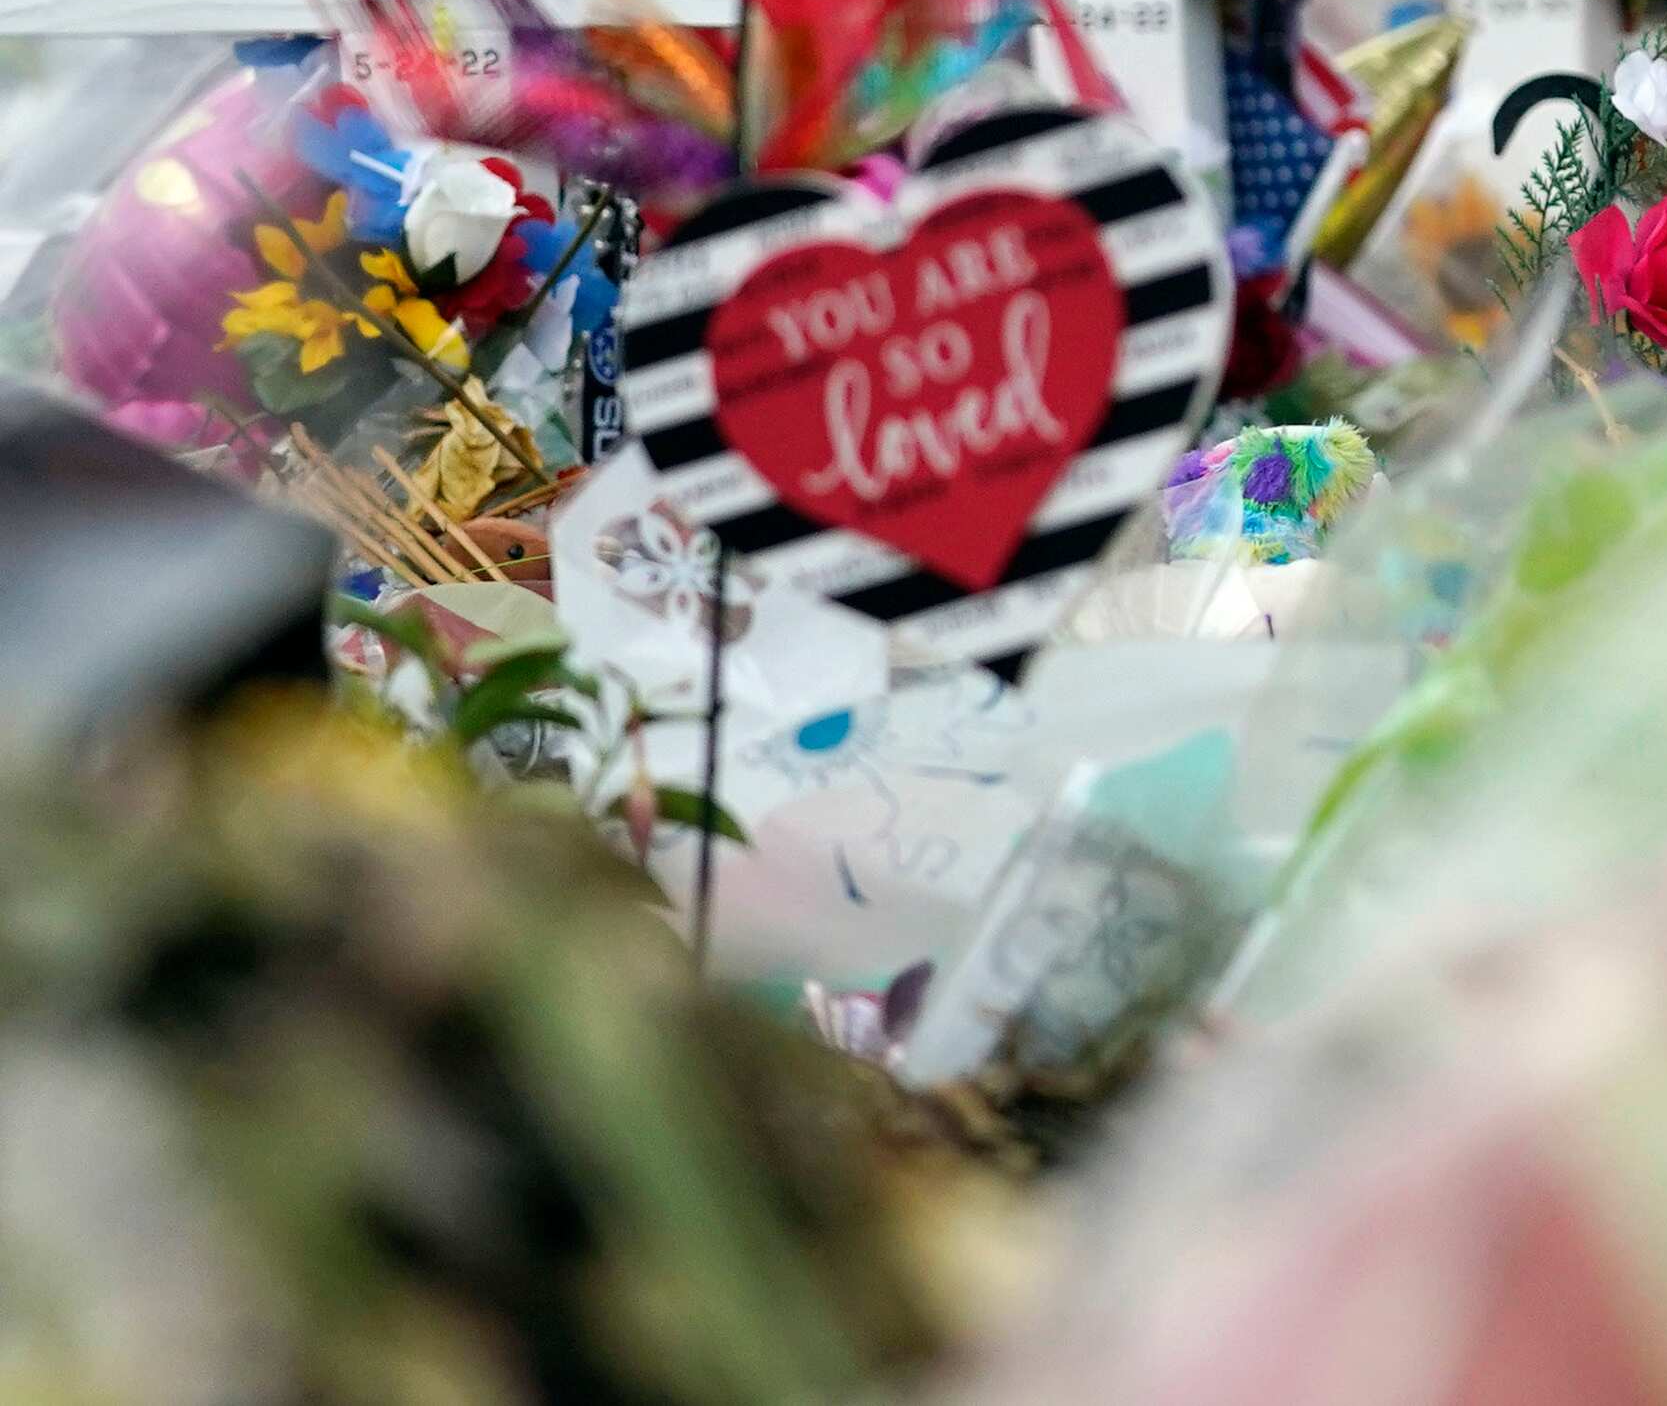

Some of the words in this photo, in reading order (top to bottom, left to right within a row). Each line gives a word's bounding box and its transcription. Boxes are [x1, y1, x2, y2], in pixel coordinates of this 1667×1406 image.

[767, 270, 898, 363] YOU
[914, 222, 1039, 318] ARE
[880, 318, 974, 399] SO
[800, 288, 1069, 501] loved
